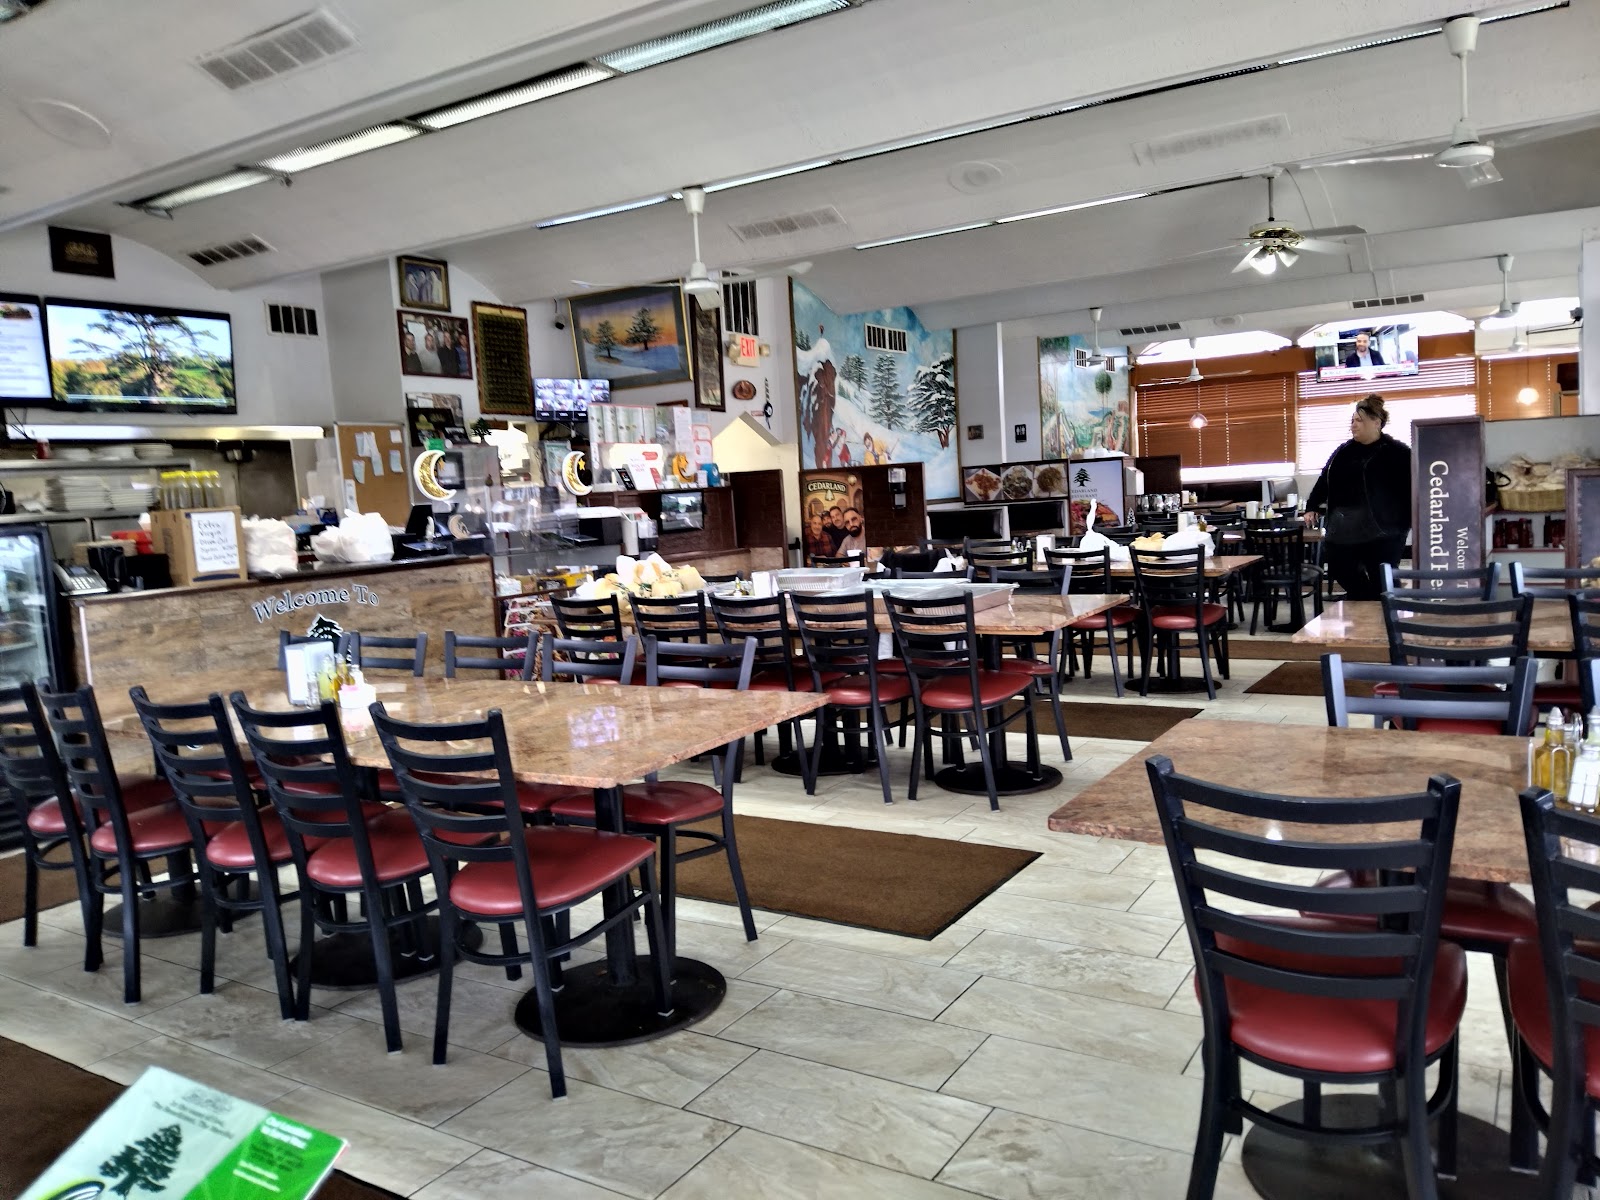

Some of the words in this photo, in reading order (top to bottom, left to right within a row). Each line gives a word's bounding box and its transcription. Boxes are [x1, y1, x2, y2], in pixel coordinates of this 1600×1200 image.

[740, 336, 756, 357] EXIT
[808, 481, 846, 492] CEDARLAND
[1429, 460, 1449, 558] Cedarland
[1456, 527, 1469, 570] Welcom
[252, 589, 350, 624] Welcome
[352, 583, 380, 607] To
